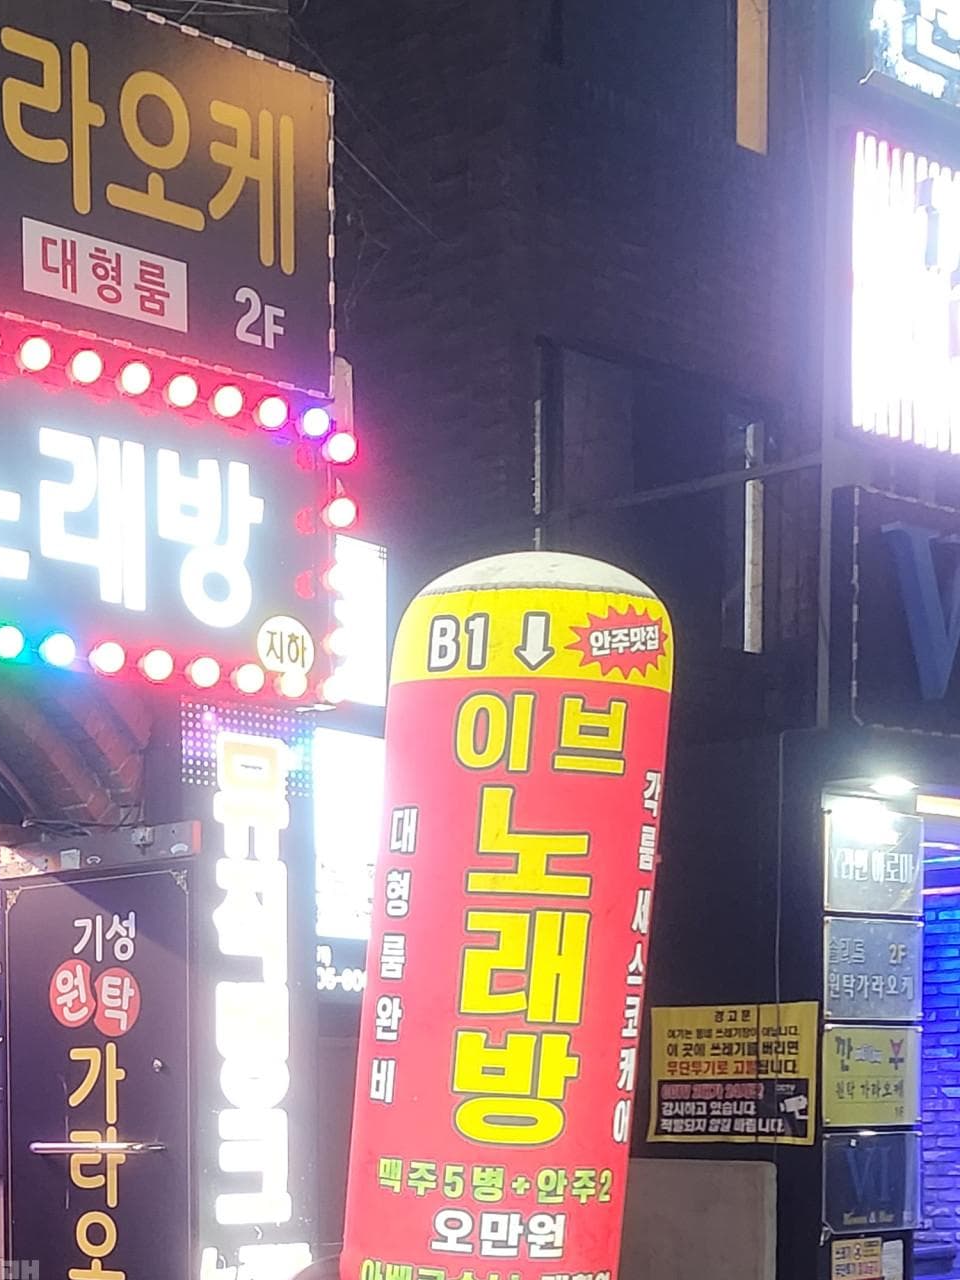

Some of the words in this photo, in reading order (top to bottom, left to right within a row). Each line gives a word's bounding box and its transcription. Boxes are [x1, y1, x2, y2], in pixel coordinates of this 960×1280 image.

[40, 235, 170, 317] 대형룸
[234, 287, 285, 349] 2F
[265, 627, 307, 670] 지하
[427, 612, 487, 671] B1
[589, 624, 660, 657] 안주맛집
[455, 692, 627, 775] 이브
[73, 911, 136, 962] 기성
[889, 944, 908, 965] 2F
[450, 784, 592, 1147] 노래방
[57, 967, 135, 1034] 원탁
[667, 1043, 679, 1057] 이
[431, 1207, 567, 1259] 오만원
